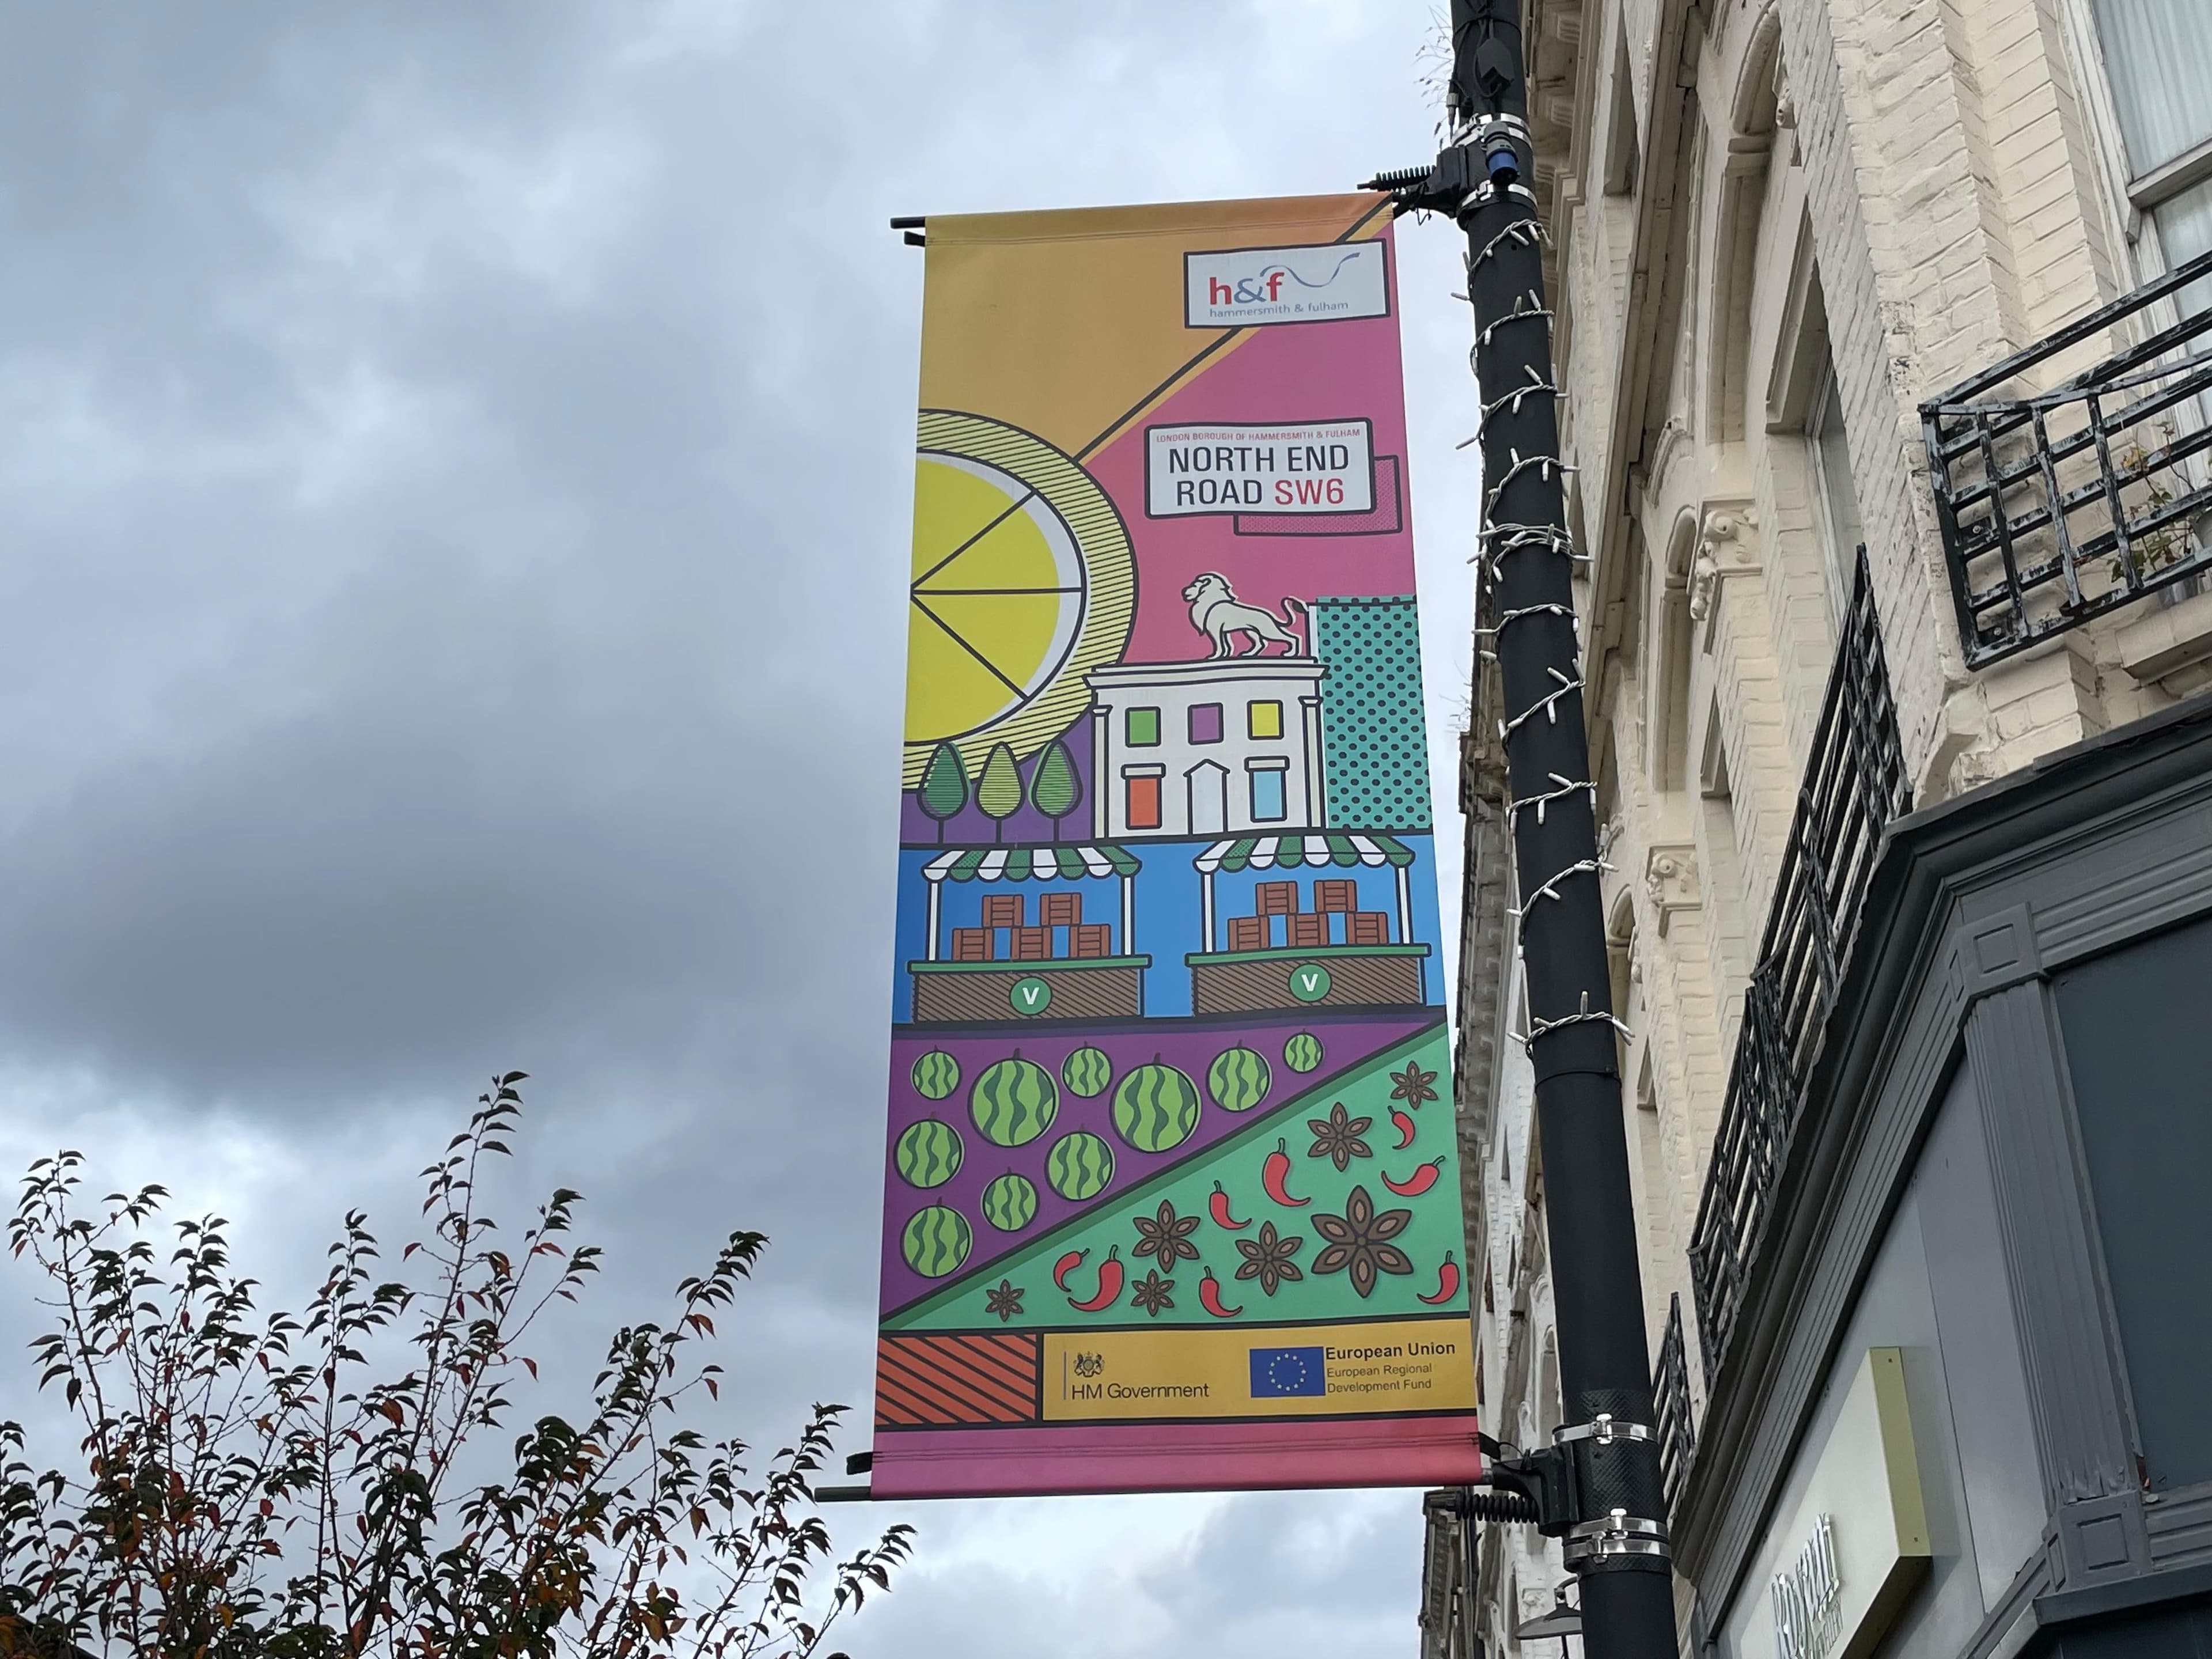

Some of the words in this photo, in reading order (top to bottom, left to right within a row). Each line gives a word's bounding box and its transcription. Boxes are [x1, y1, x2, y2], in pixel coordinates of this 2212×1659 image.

[1209, 271, 1285, 305] h&f
[1209, 304, 1291, 318] hammersmith
[1294, 304, 1304, 313] &
[1308, 301, 1349, 312] fulham
[1156, 433, 1190, 443] LONDON
[1192, 432, 1233, 441] BOROUGH
[1235, 433, 1245, 441] OF
[1248, 431, 1314, 441] HAMMERSMITH
[1316, 431, 1323, 439] &
[1325, 429, 1361, 438] FULHAM
[1169, 446, 1274, 474] NORTH
[1288, 445, 1349, 472] END
[1177, 479, 1262, 506] ROAD
[1274, 478, 1344, 505] SW6
[1301, 974, 1319, 992] V
[1022, 987, 1040, 1005] V
[1325, 1346, 1403, 1361] European
[1408, 1342, 1456, 1355] Union
[1327, 1367, 1380, 1378] European
[1383, 1363, 1432, 1376] Regional
[1072, 1384, 1103, 1400] HM
[1107, 1383, 1210, 1399] Government
[1327, 1380, 1400, 1393] Development
[1404, 1378, 1432, 1389] Fund
